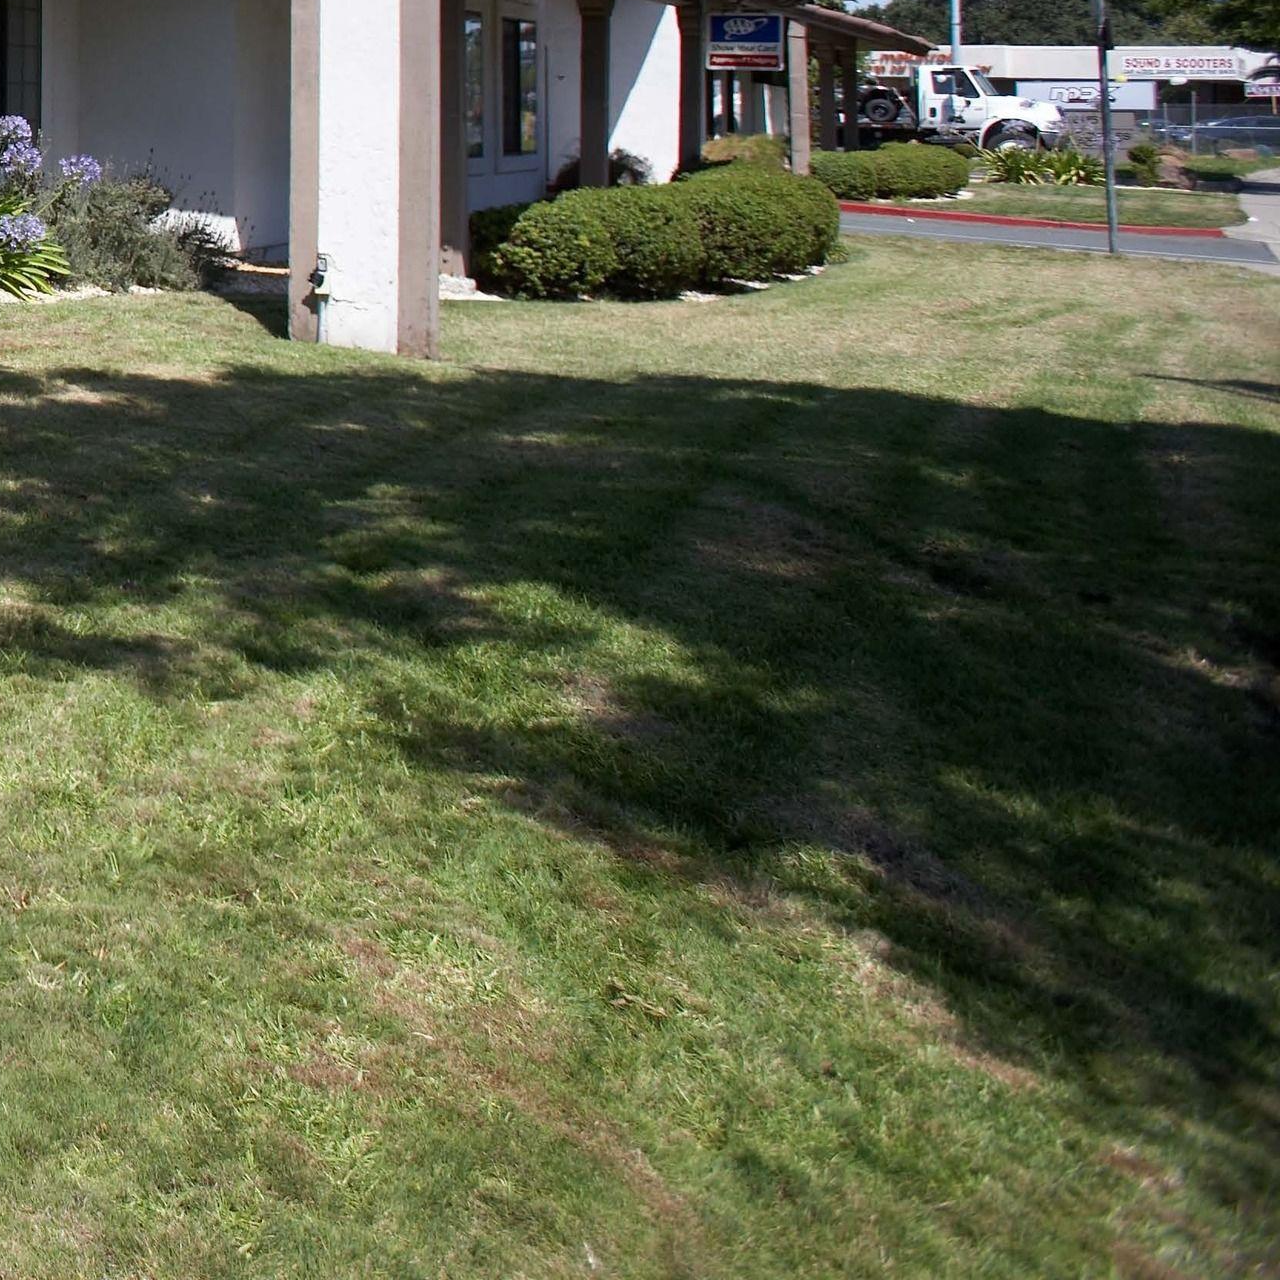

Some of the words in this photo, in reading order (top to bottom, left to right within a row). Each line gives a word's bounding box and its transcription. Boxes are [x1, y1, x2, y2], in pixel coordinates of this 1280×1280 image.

[1125, 58, 1161, 69] SOUND
[1164, 58, 1171, 69] &
[1175, 58, 1233, 69] SCOOTERS
